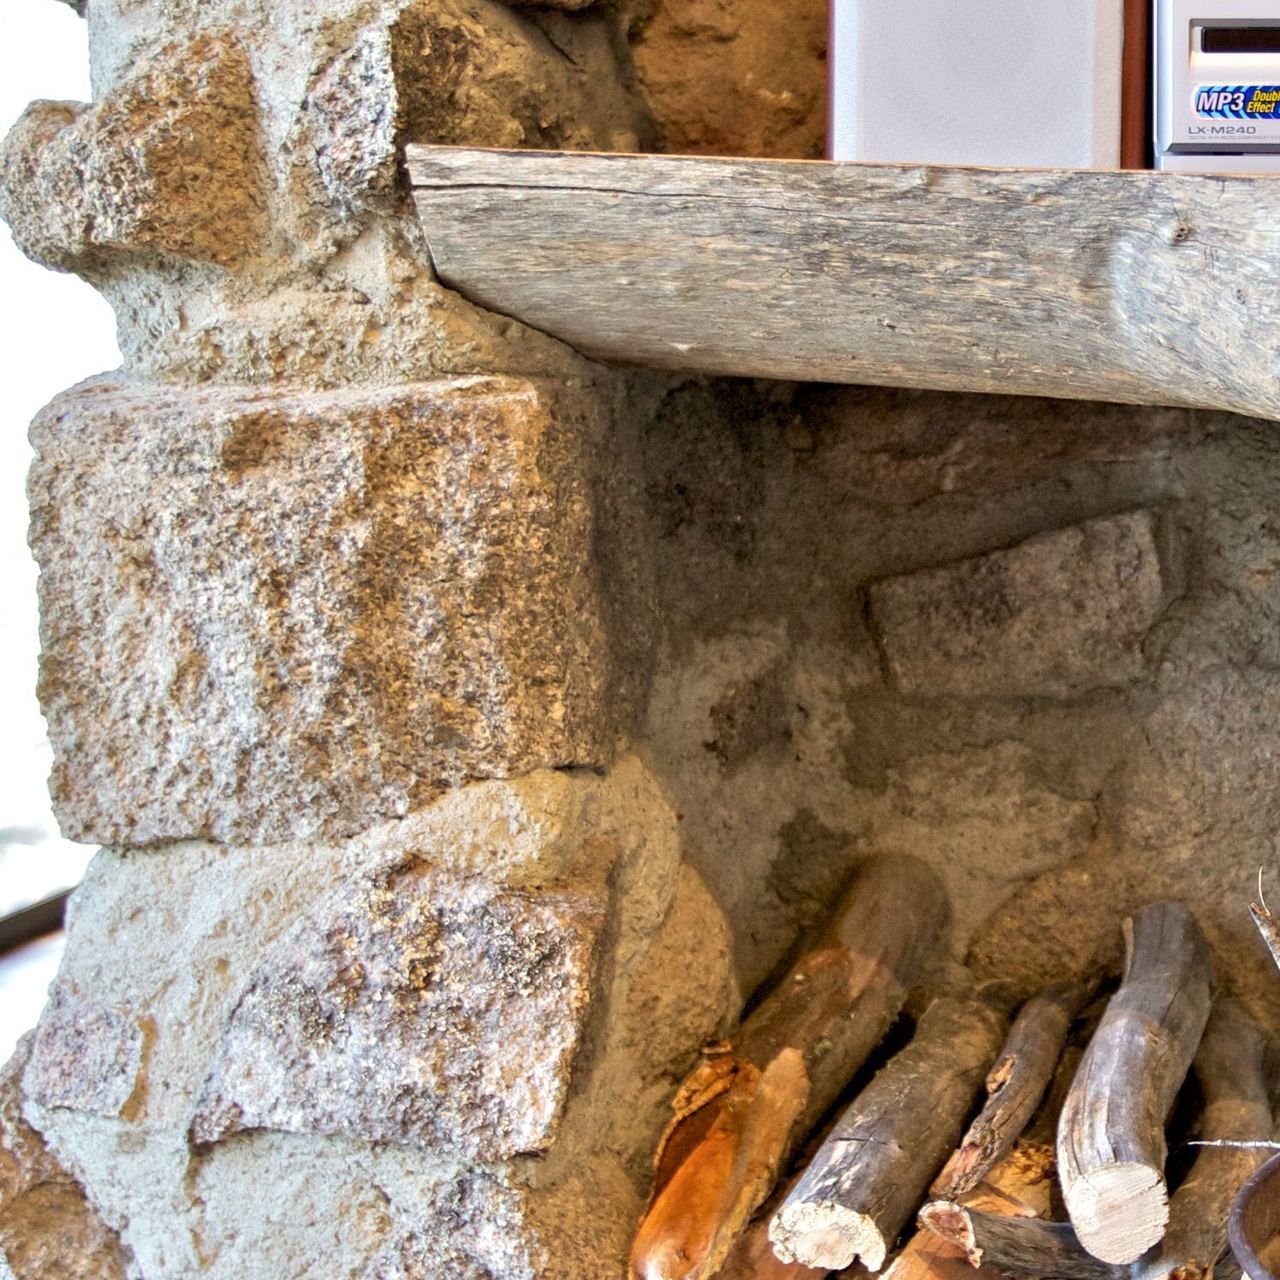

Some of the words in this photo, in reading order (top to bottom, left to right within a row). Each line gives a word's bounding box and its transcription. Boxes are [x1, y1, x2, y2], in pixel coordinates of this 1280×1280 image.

[1196, 91, 1244, 112] MP3
[1246, 101, 1276, 113] Effect
[1188, 126, 1257, 135] LX-M240
